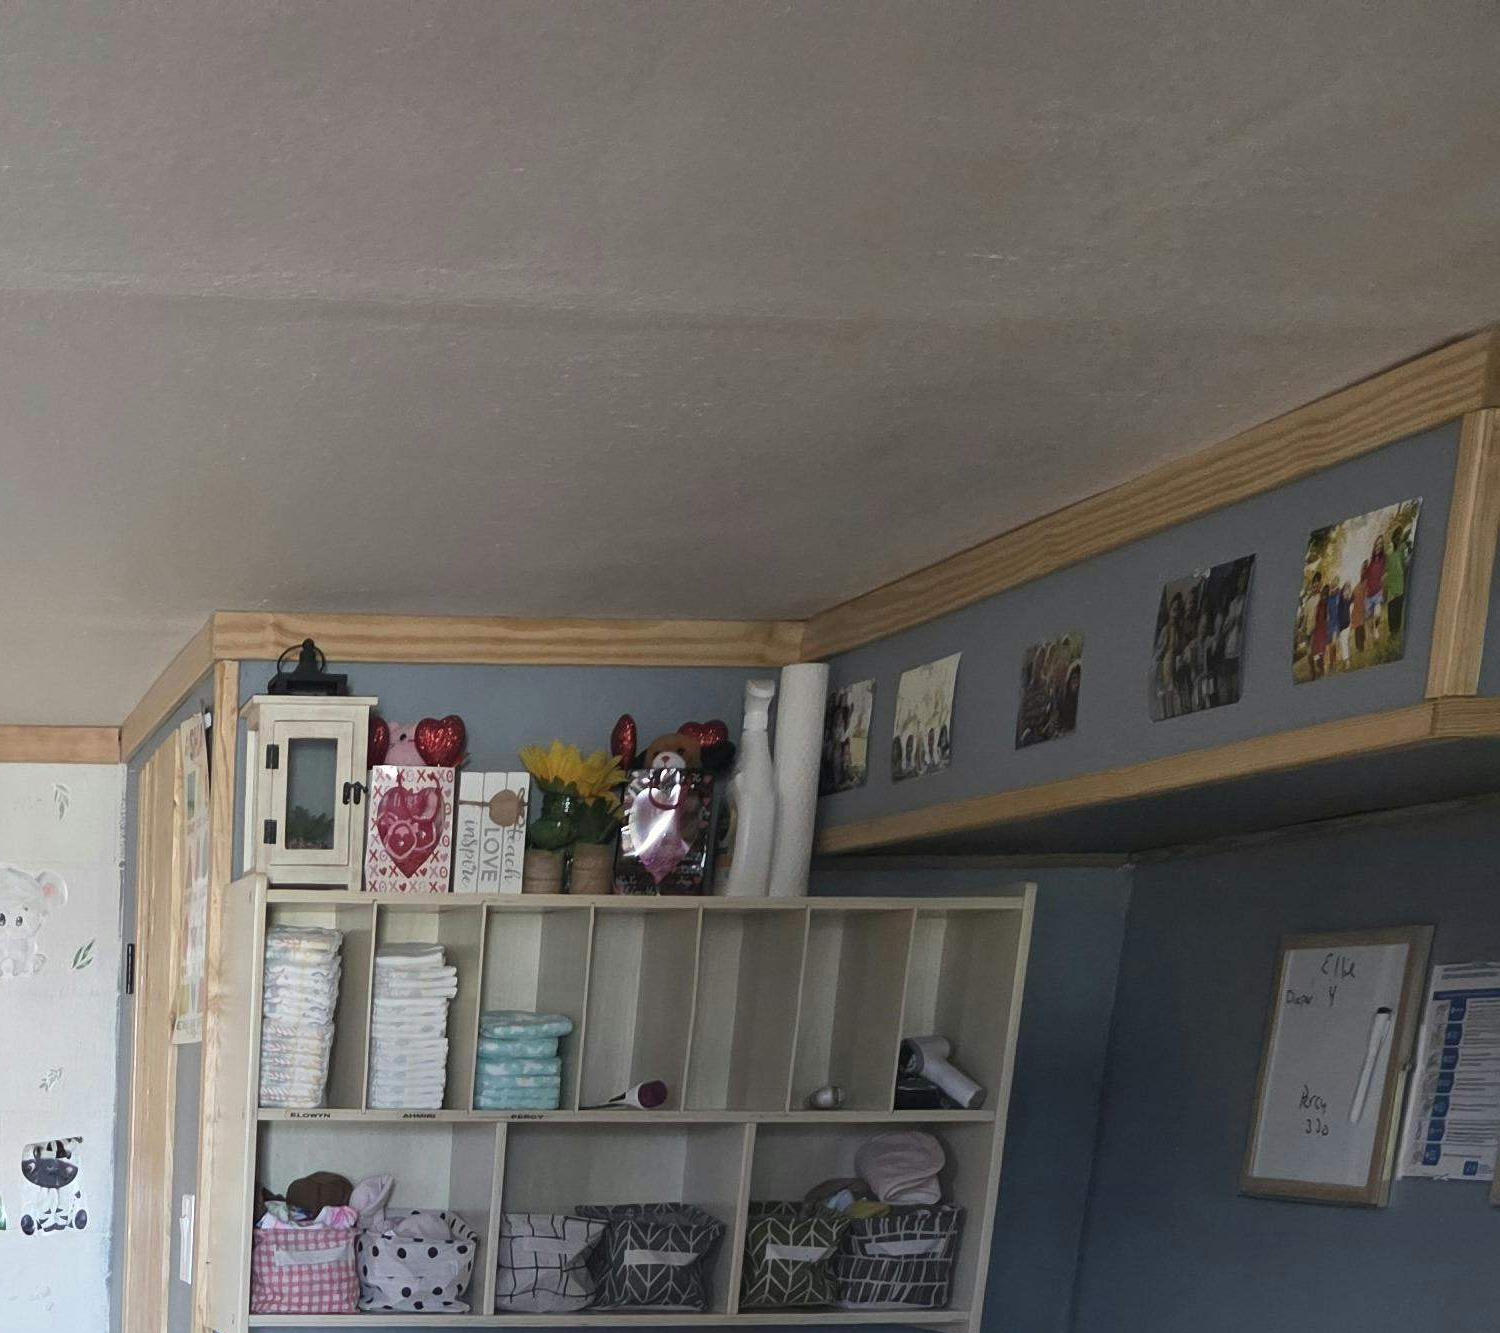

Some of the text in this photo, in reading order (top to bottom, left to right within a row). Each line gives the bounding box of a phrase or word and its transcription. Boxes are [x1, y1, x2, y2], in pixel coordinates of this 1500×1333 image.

[458, 820, 478, 886] inspire
[481, 828, 500, 882] LOVE
[504, 828, 523, 881] teach
[1299, 1084, 1327, 1113] Percy
